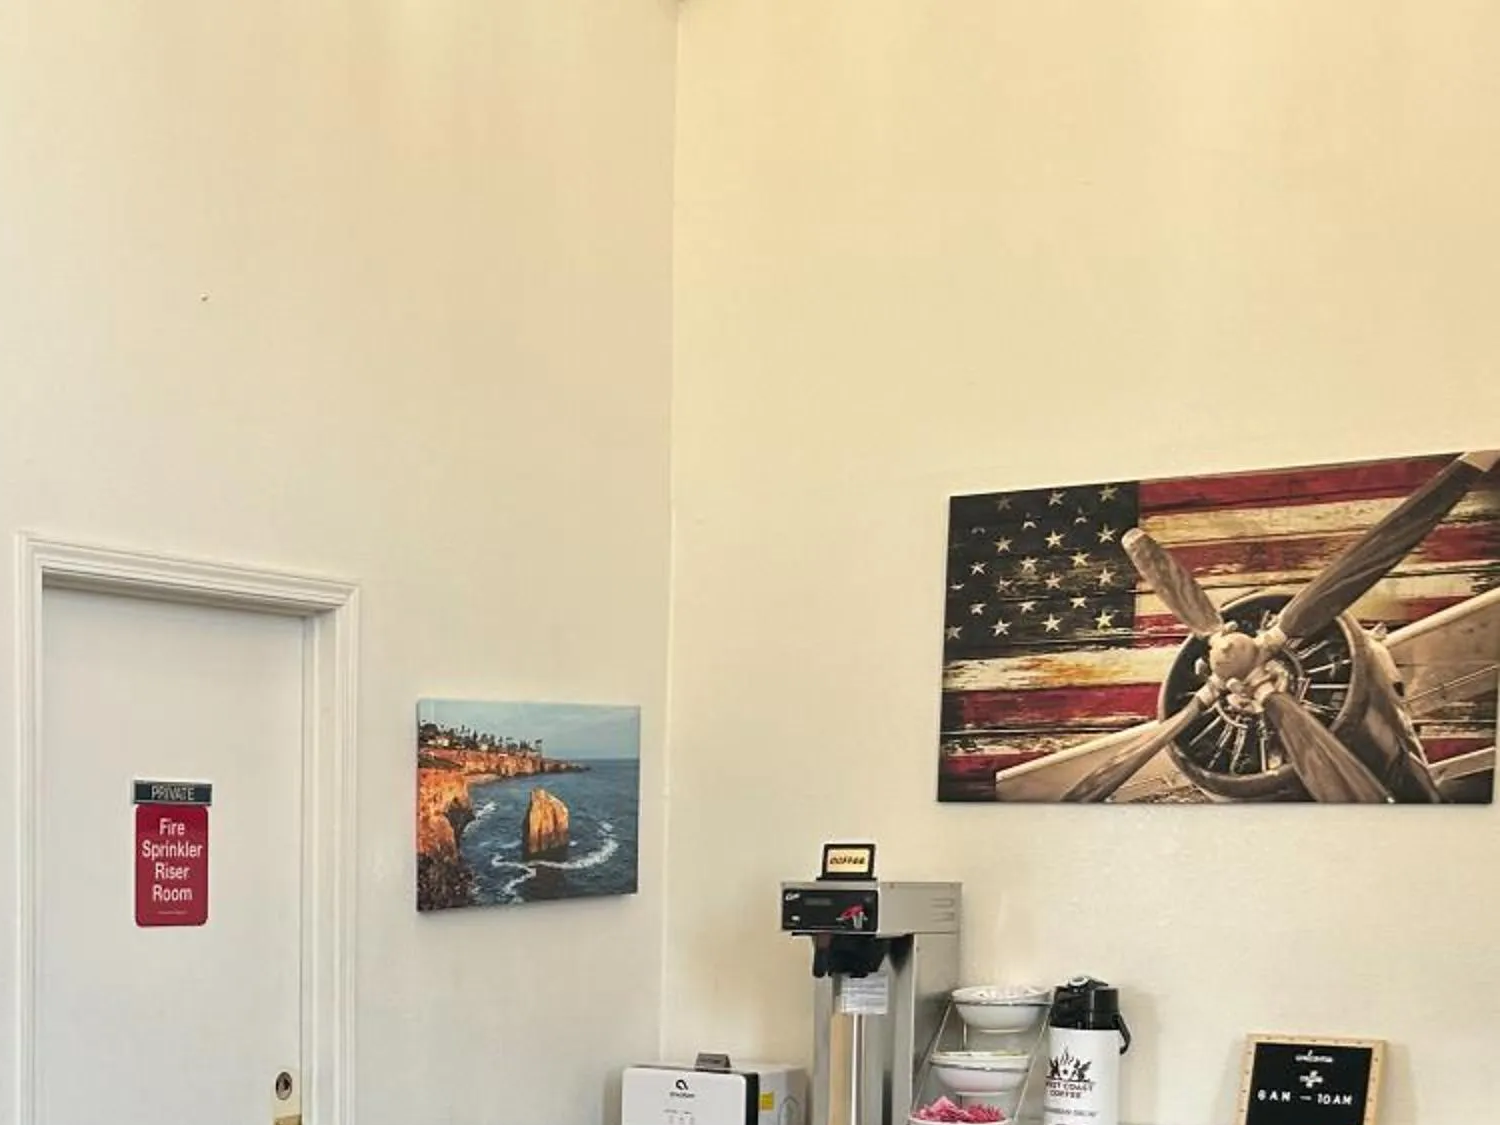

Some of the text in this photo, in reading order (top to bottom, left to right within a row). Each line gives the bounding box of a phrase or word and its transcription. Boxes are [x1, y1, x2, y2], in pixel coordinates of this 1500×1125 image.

[151, 785, 195, 801] PRIVATE
[159, 818, 186, 836] Fire
[141, 840, 203, 861] Sprinkler
[155, 862, 190, 880] Riser
[152, 884, 193, 902] Room
